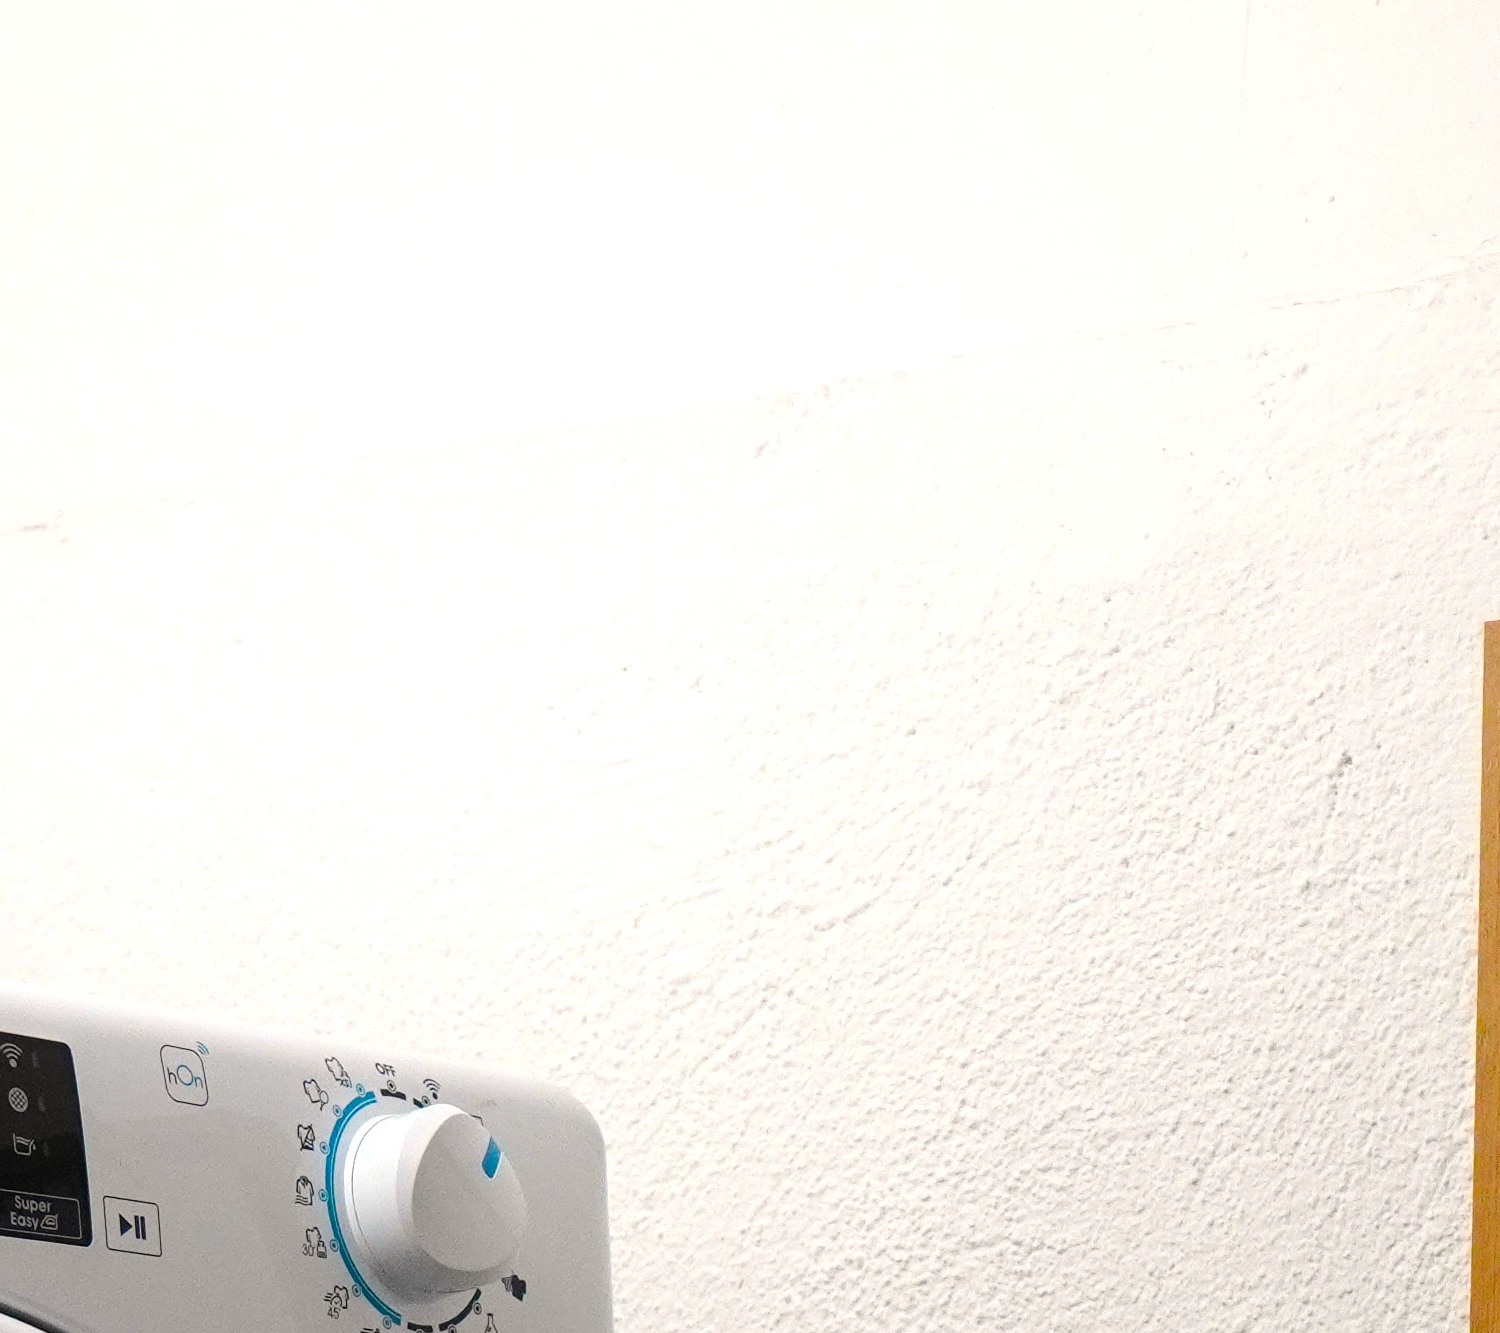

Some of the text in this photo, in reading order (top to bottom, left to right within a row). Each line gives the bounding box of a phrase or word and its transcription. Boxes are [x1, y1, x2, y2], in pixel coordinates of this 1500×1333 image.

[375, 1062, 396, 1077] OFF
[14, 1195, 52, 1213] Super
[10, 1211, 39, 1230] Easy
